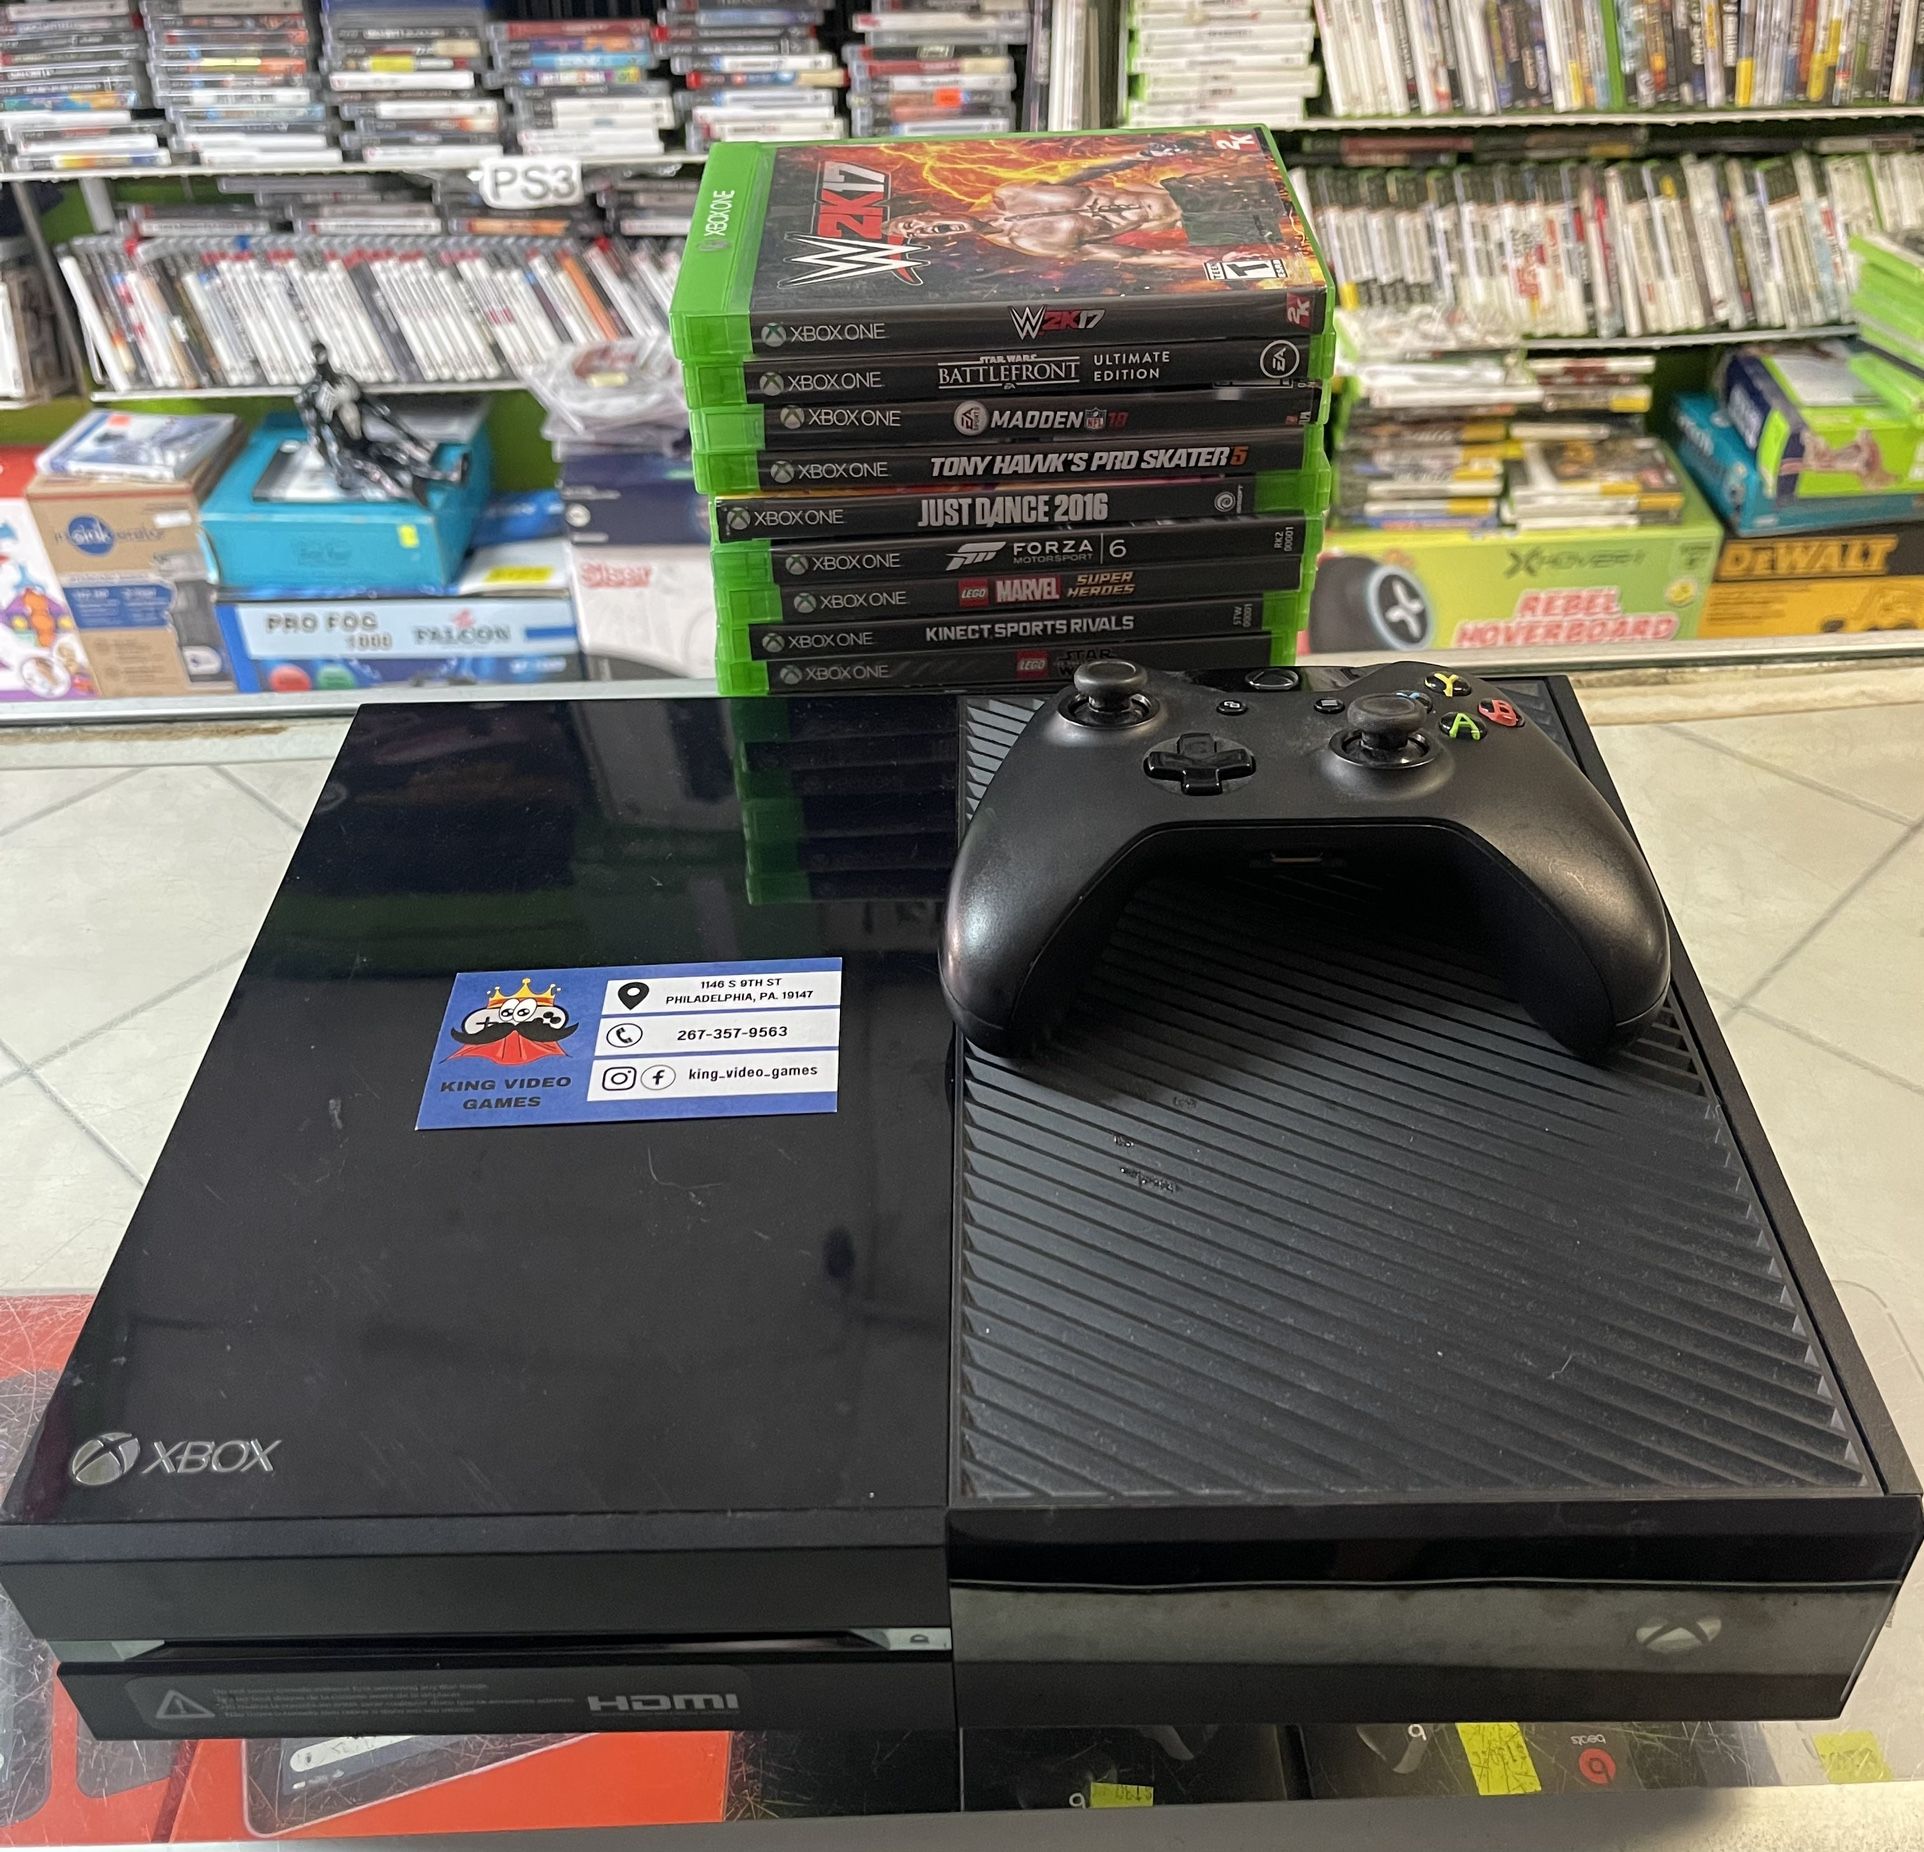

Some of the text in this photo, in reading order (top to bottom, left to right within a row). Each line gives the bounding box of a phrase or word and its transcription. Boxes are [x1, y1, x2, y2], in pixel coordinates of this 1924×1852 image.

[1215, 134, 1256, 150] 2K
[490, 165, 577, 201] PS3
[704, 190, 735, 236] XBOX ONE
[1286, 297, 1310, 325] 2K
[789, 323, 887, 342] XBOX ONE
[1006, 354, 1038, 362] WARS
[1093, 351, 1171, 366] ULTIMATE
[787, 372, 883, 391] XBOX ONE
[938, 362, 1081, 385] BATTLEFRONT
[1093, 368, 1161, 382] EDITION
[808, 409, 901, 426] XBOX ONE
[990, 411, 1083, 429] MADDEN
[798, 462, 889, 479] XBOX ONE
[931, 446, 1248, 477] TONY HAWK'S PRO SKATER 5
[754, 509, 845, 527] XBOX ONE
[918, 493, 1108, 527] JUST DANCE 2016
[1012, 539, 1127, 558] FORZA 6
[812, 553, 901, 571] XBOX ONE
[1013, 553, 1093, 565] MOTORSPORT
[1076, 571, 1134, 585] SUPER
[961, 587, 987, 599] LEGO
[997, 576, 1060, 602] MARVEL
[1066, 583, 1136, 599] HEROES
[820, 591, 907, 609] XBOX ONE
[1518, 588, 1622, 617] REBEL
[266, 612, 379, 633] PRO FOG
[926, 615, 1135, 642] KINECT SPORTS RIVALS
[413, 625, 512, 645] FALCON
[788, 632, 874, 649] XBOX ONE
[1458, 617, 1678, 648] HOVERBOARD
[806, 664, 889, 681] XBOX ONE
[1019, 658, 1047, 671] LEGO
[1434, 673, 1458, 697] Y
[1450, 712, 1480, 740] A
[701, 978, 783, 989] 1146 S 9TH ST
[665, 992, 757, 1004] PHILADELPHIA,
[782, 990, 814, 1000] 19147
[677, 1026, 788, 1041] 267-357-9563
[688, 1065, 819, 1082] king_video_games
[440, 1076, 572, 1093] KING VIDEO
[462, 1096, 542, 1111] GAMES
[141, 1438, 283, 1475] XBOX
[587, 1693, 740, 1712] HDMI
[1570, 1734, 1607, 1745] beats
